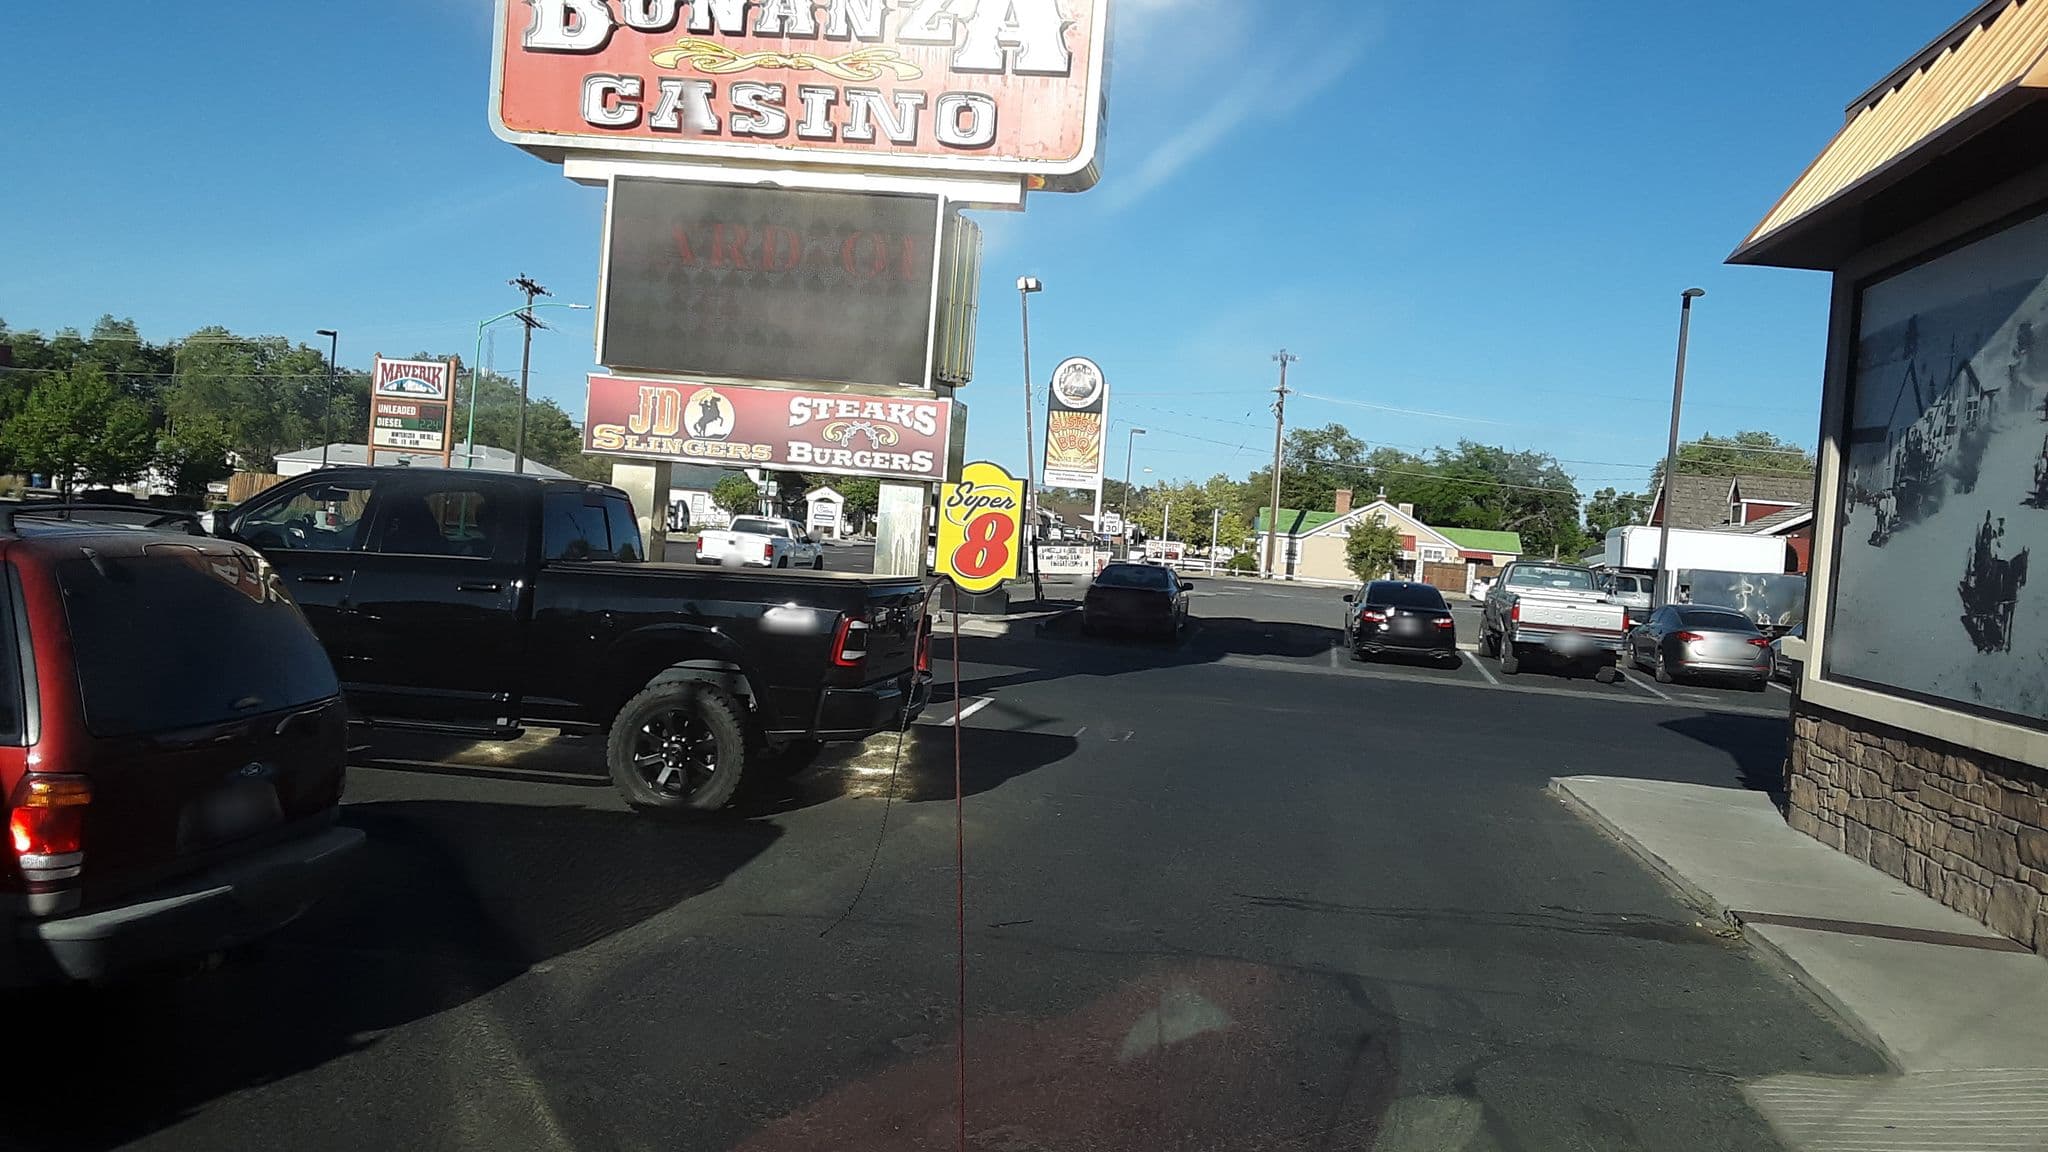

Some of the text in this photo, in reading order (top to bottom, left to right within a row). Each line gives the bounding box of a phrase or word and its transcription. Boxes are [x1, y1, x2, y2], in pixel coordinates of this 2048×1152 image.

[581, 74, 1000, 148] CASINO
[379, 363, 443, 394] MAVERIK
[377, 417, 402, 428] DIESEL
[378, 404, 416, 415] UNLEADED
[629, 386, 681, 436] JD
[789, 396, 937, 436] STEAKS
[787, 441, 935, 473] BURGERS
[1059, 435, 1090, 454] BBQ
[947, 482, 1016, 520] Super
[951, 512, 1014, 579] 8
